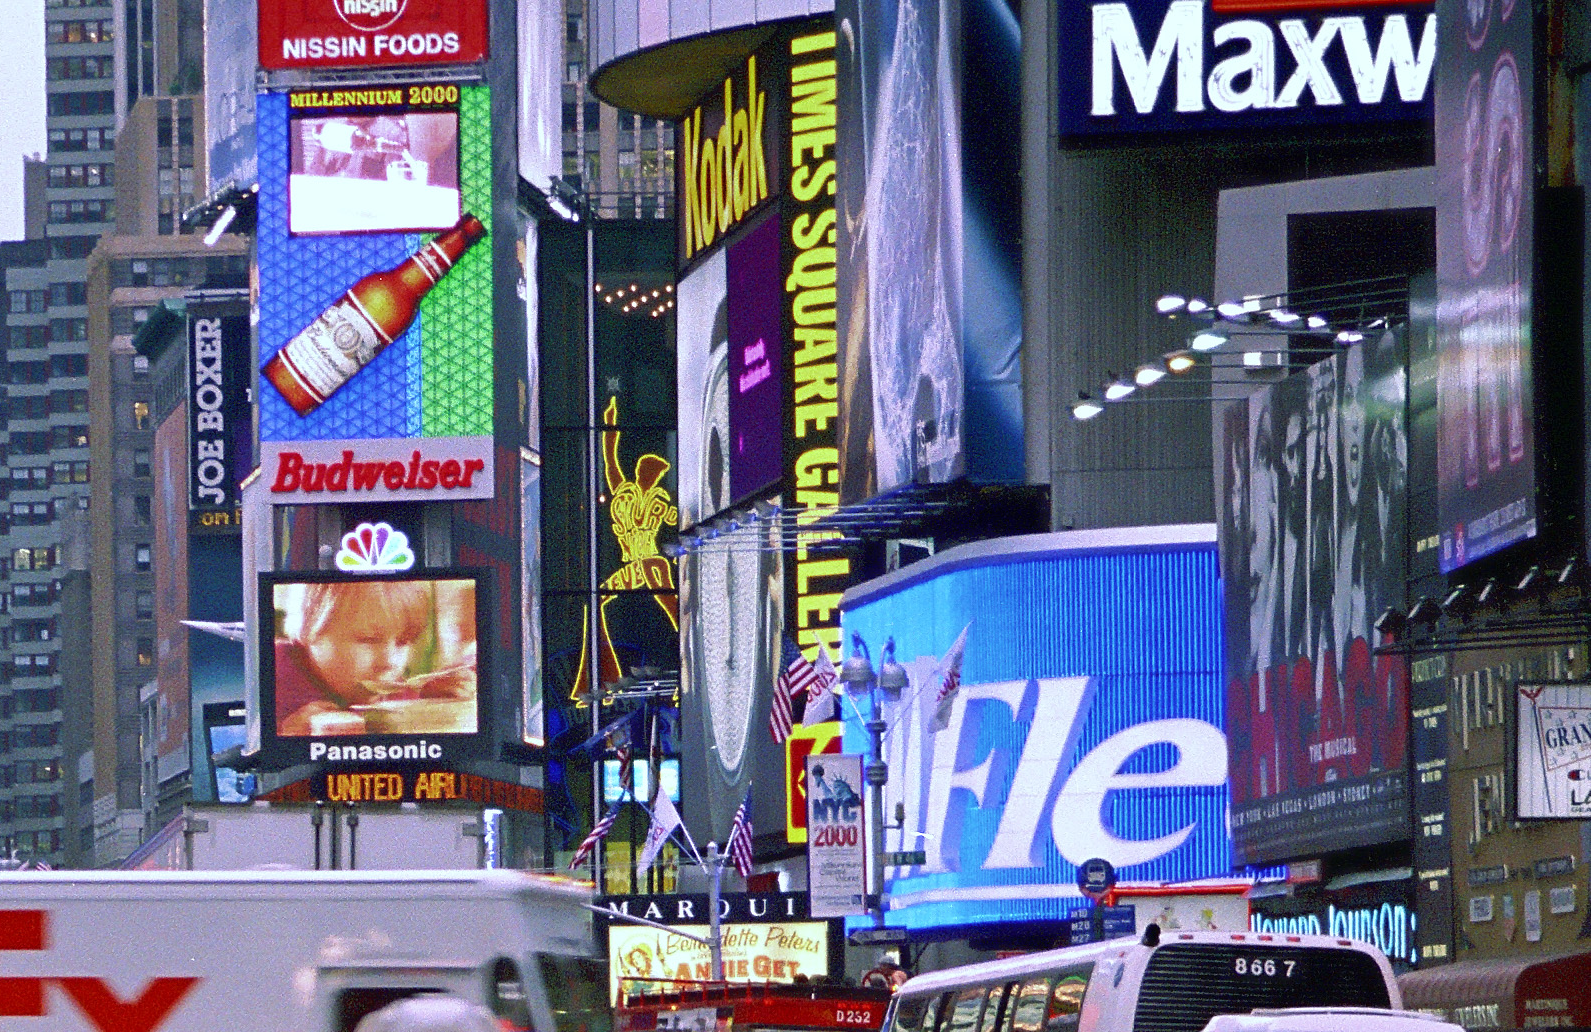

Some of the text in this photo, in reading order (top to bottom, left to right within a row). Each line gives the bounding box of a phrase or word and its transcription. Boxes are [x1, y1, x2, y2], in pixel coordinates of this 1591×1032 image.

[282, 32, 460, 60] NISSIN FOODS
[1091, 1, 1437, 116] Maxw
[290, 85, 458, 108] MILLENNIUM 2000
[684, 54, 768, 260] Kodak
[785, 208, 838, 438] SQUARE
[194, 317, 226, 505] JOE BOXER
[270, 449, 485, 494] Budweiser
[309, 741, 443, 761] Panasonic
[1324, 736, 1357, 760] MUSICAL
[326, 773, 404, 801] UNITED
[812, 798, 859, 824] NYC
[813, 825, 859, 848] 2000
[667, 926, 759, 956] Berndette
[764, 926, 822, 954] Peters
[673, 960, 750, 981] ANIE
[753, 954, 802, 979] GET
[1234, 957, 1297, 978] 8667
